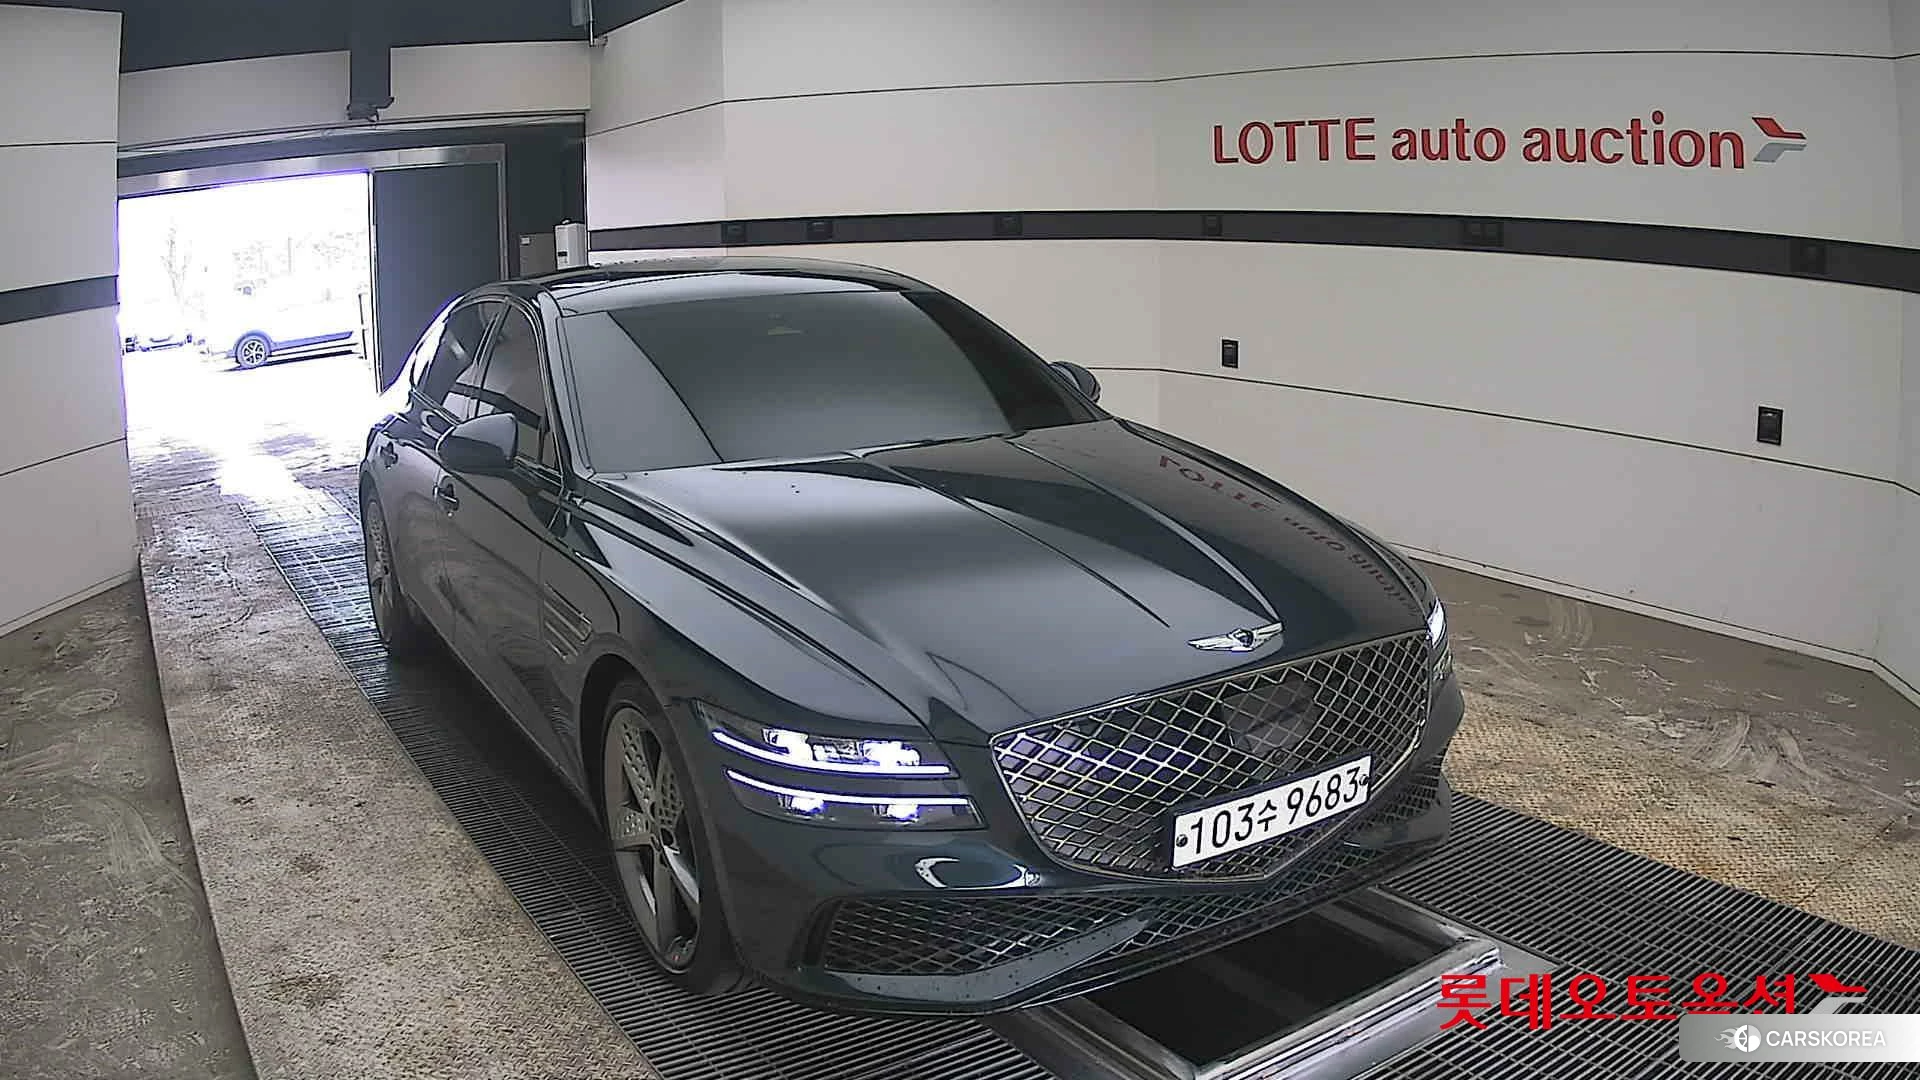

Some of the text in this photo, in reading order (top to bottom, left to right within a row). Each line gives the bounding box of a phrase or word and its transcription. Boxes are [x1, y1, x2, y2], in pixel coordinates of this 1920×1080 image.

[1213, 110, 1745, 169] LOTTE auto auction
[1287, 766, 1361, 825] 9683
